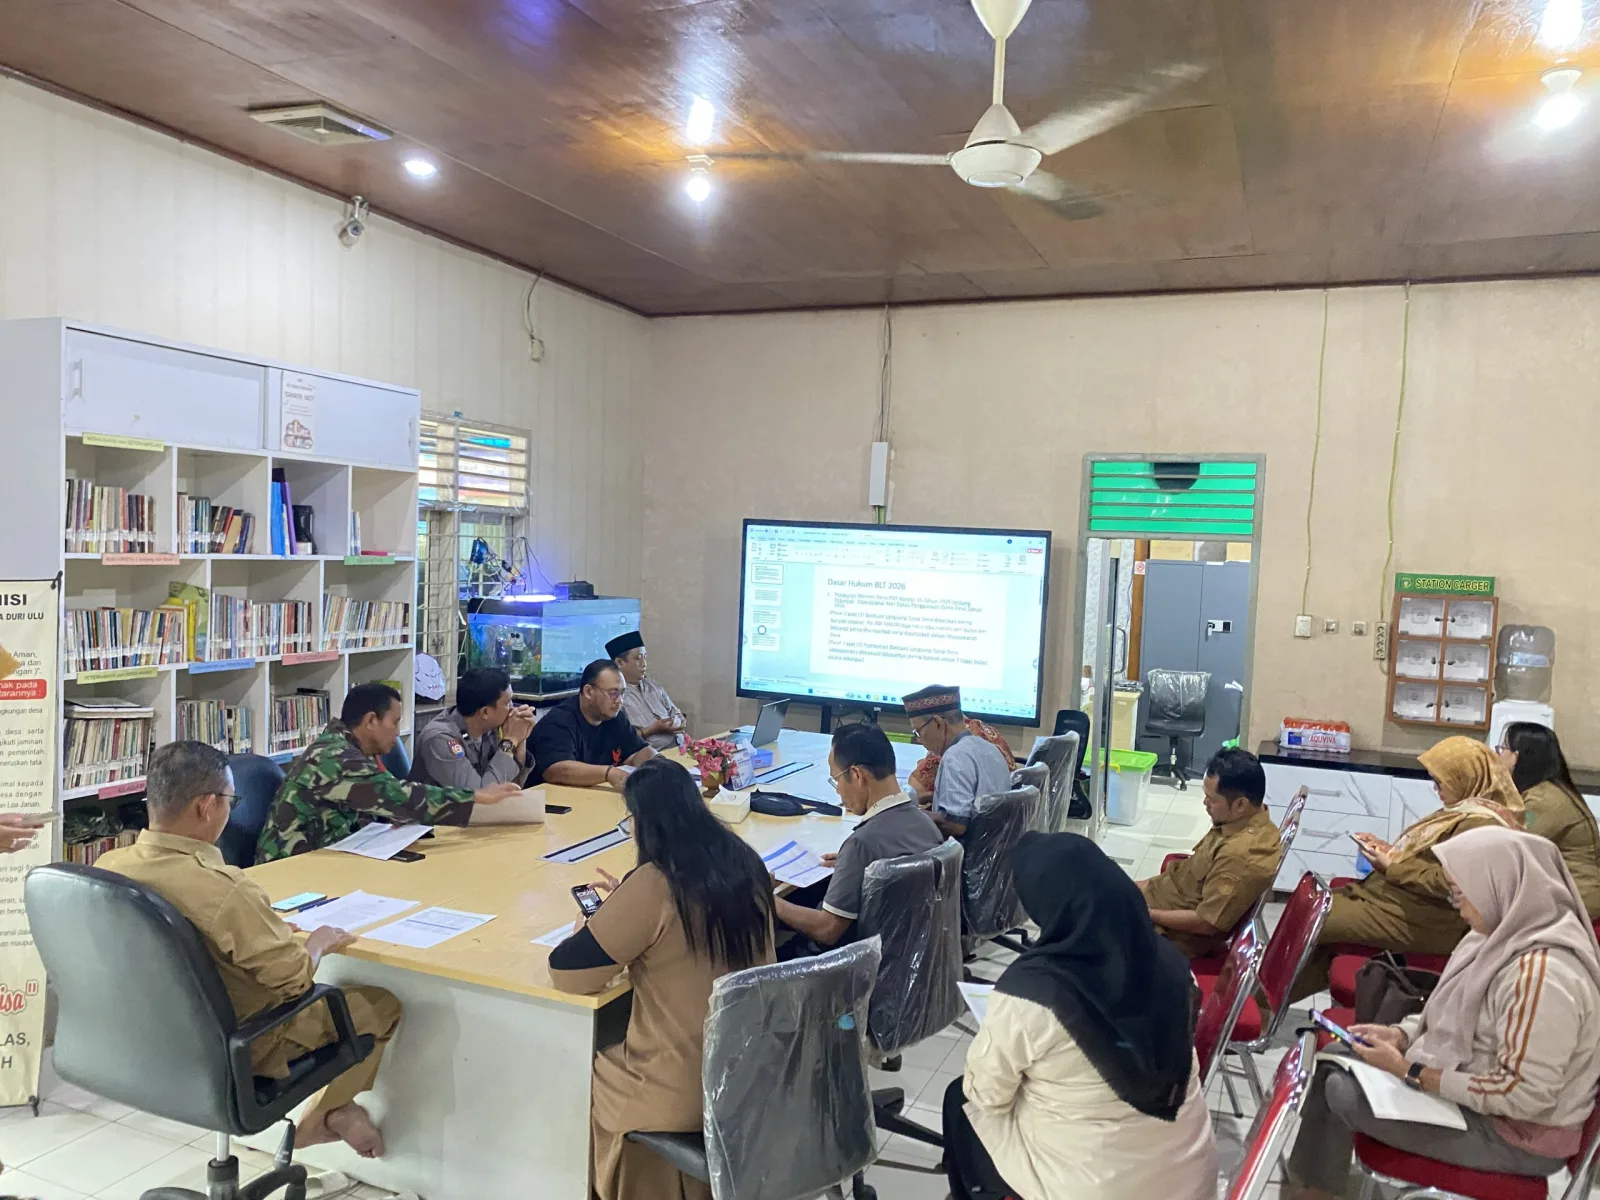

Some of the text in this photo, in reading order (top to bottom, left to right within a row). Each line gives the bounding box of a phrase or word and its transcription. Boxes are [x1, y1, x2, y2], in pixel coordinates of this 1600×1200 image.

[1416, 578, 1490, 591] STATION CARGER
[0, 594, 27, 606] ISI
[16, 682, 38, 690] pada
[18, 780, 44, 788] kepada
[1, 1056, 12, 1068] H
